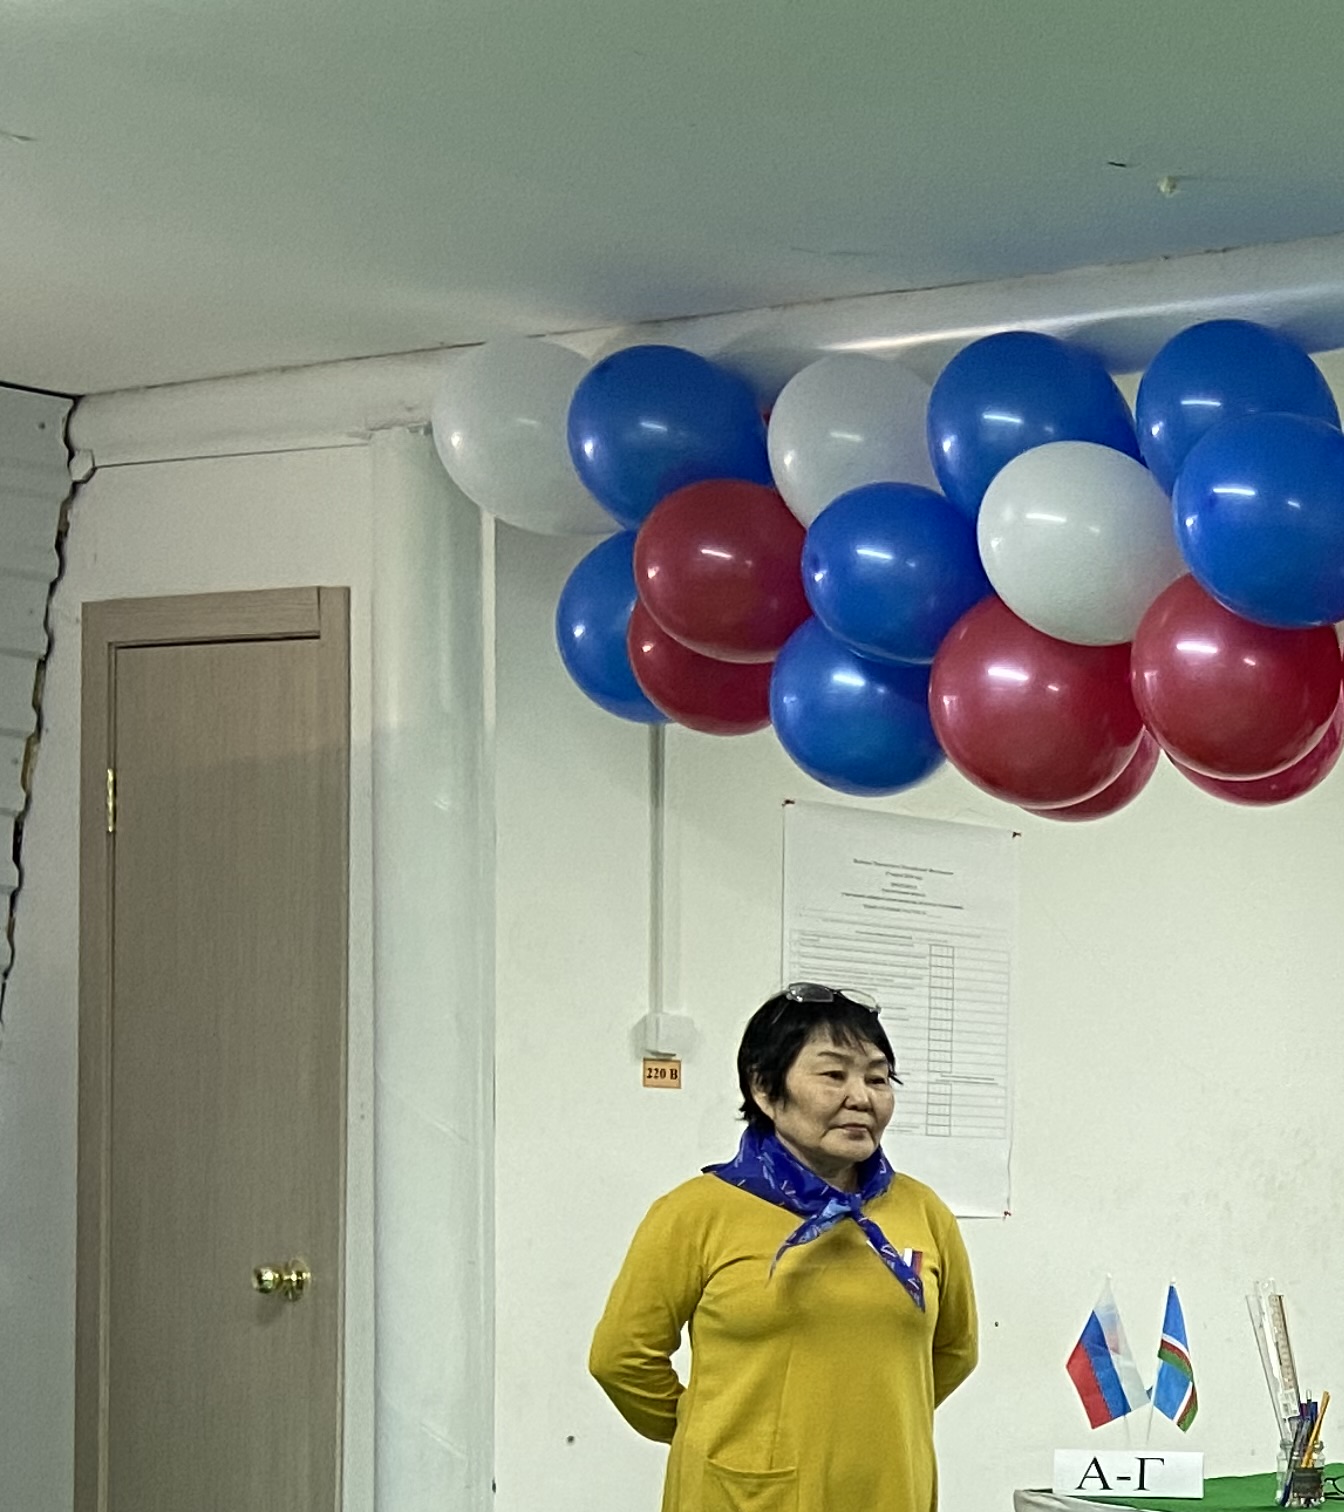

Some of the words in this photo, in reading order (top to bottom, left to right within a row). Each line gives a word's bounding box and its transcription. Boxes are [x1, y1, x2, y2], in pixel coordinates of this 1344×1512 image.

[646, 1067, 667, 1079] 220
[669, 1068, 678, 1080] В
[1074, 1456, 1165, 1491] А-Г
